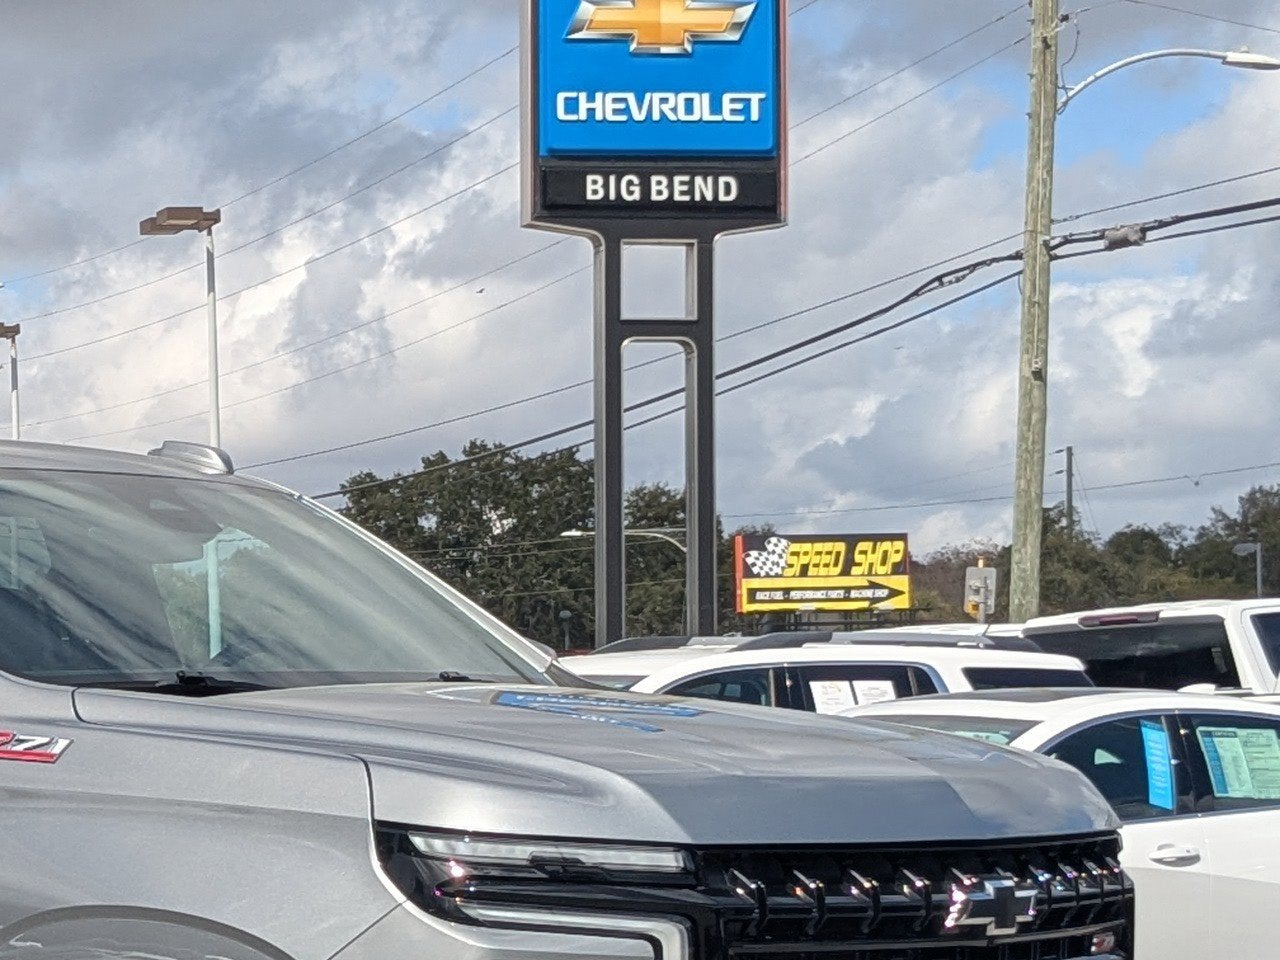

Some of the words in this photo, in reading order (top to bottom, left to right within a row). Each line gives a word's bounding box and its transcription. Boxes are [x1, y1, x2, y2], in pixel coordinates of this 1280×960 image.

[556, 91, 766, 122] CHEVROLET
[585, 174, 641, 201] BIG
[650, 175, 738, 202] BEND
[783, 542, 846, 576] SPEED
[850, 540, 905, 575] SHOP
